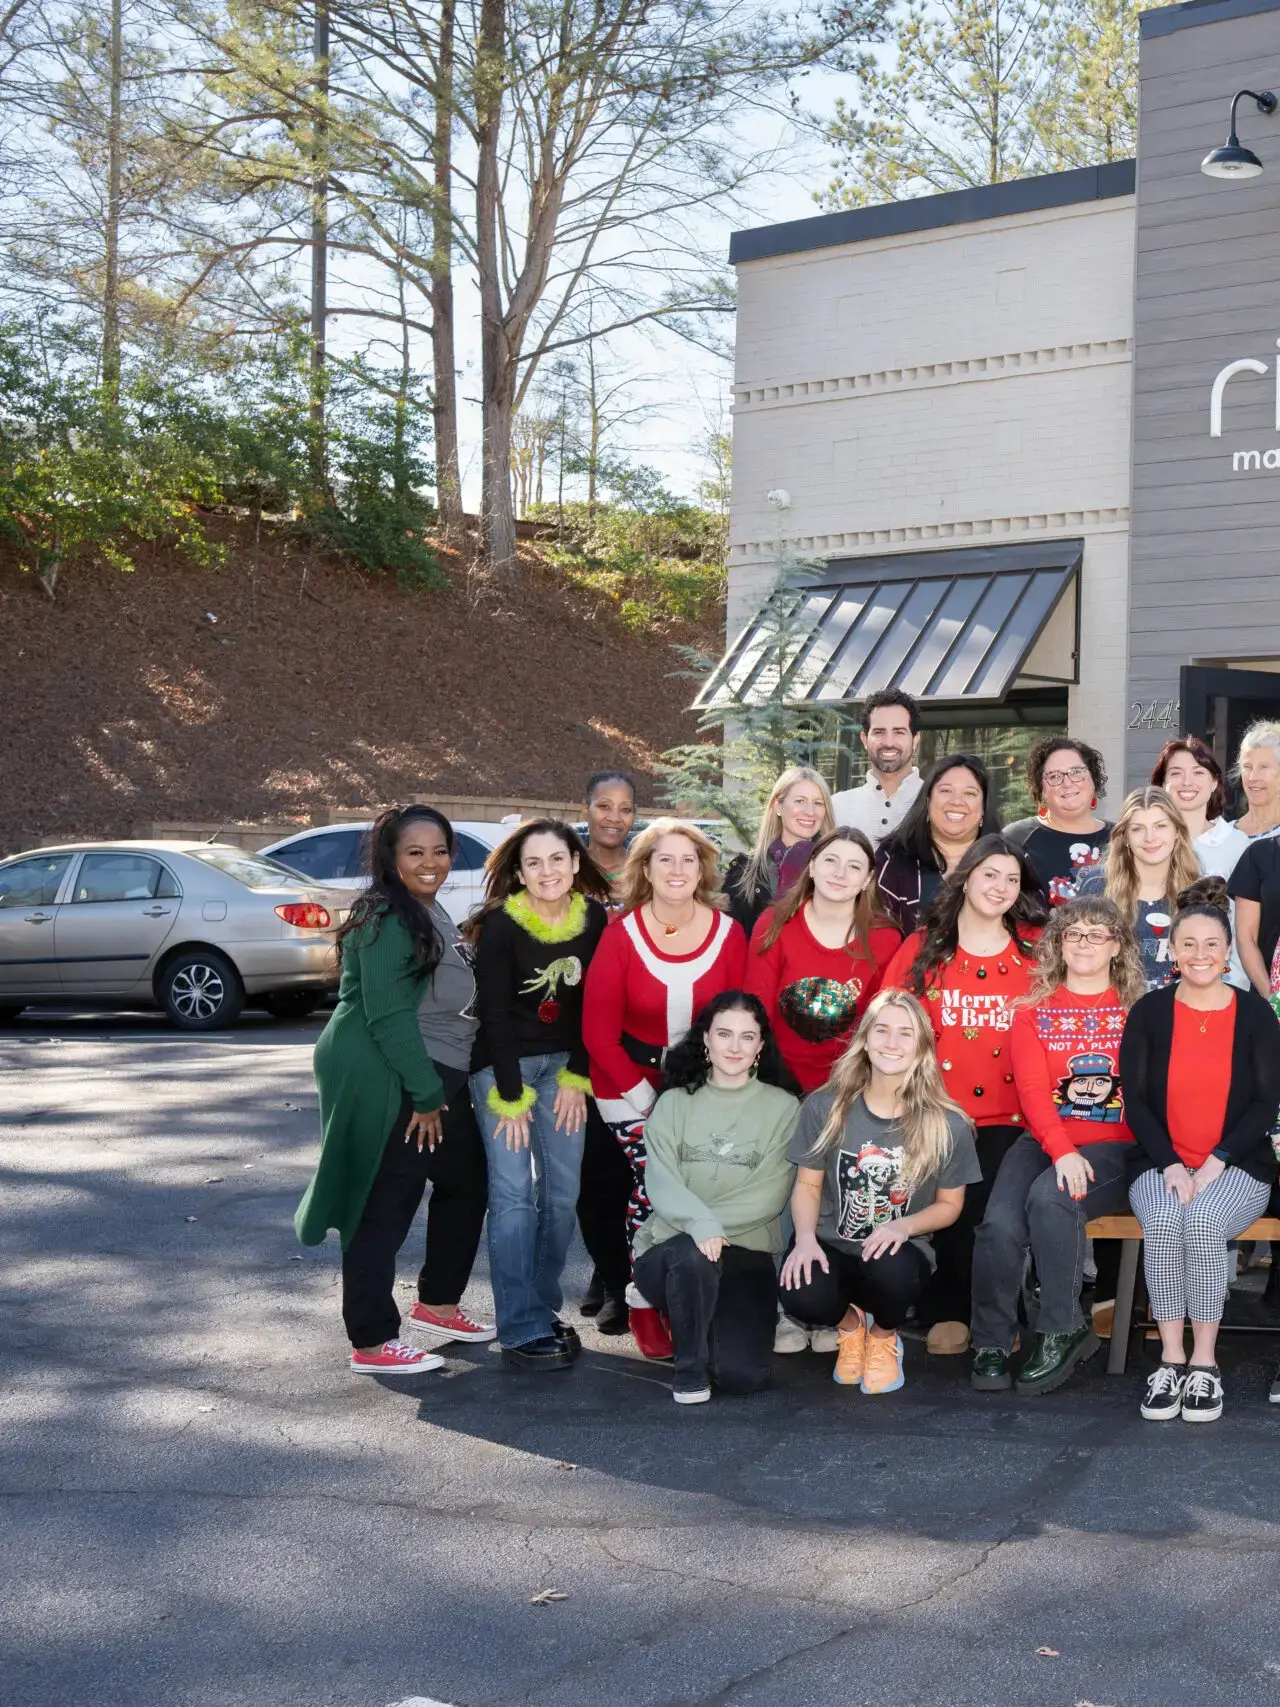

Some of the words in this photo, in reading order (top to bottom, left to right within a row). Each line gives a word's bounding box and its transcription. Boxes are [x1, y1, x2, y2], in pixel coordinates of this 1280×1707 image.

[941, 989, 1009, 1012] Merry
[941, 1008, 957, 1027] &
[1048, 1041, 1072, 1051] NOT
[1077, 1042, 1085, 1051] A
[1091, 1040, 1122, 1050] PLAY
